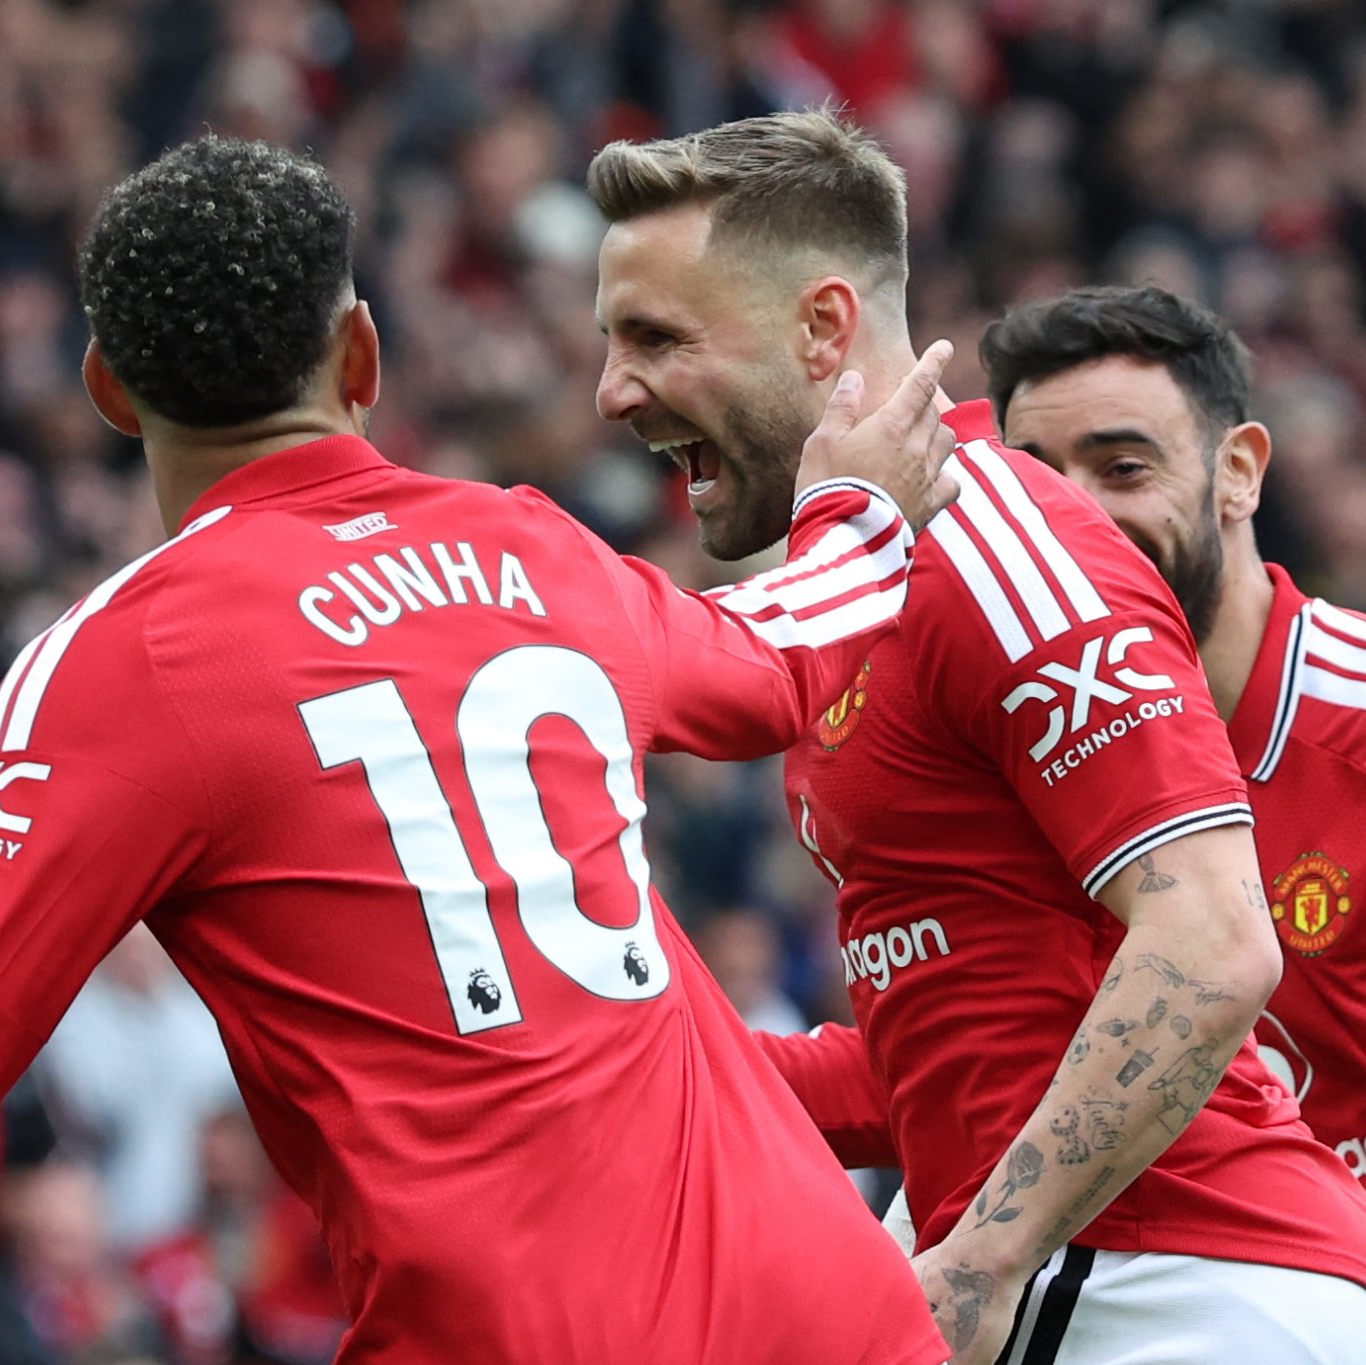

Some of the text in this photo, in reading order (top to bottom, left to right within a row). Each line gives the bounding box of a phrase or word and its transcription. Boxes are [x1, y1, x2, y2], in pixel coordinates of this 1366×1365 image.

[326, 514, 392, 541] UNITED
[299, 540, 548, 646] CUNHA
[1041, 696, 1184, 787] TECHNOLOGY
[296, 643, 671, 1036] 10
